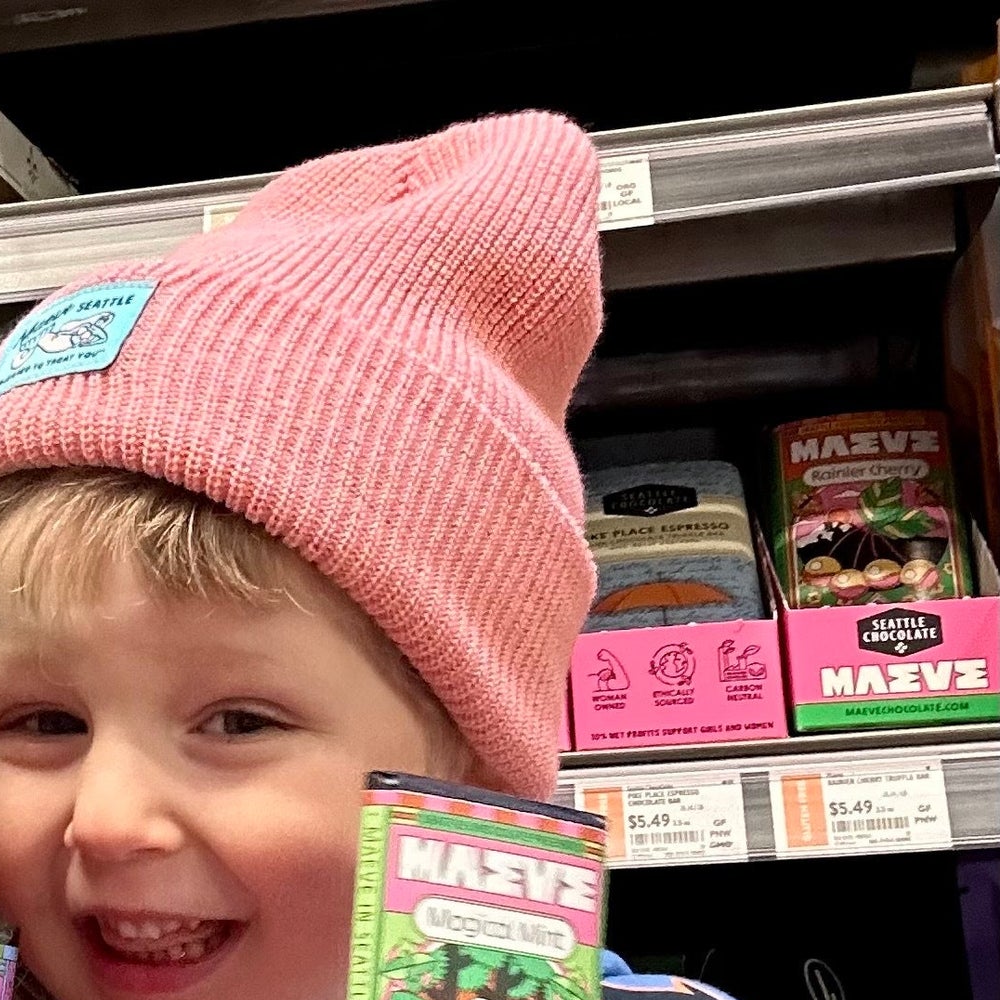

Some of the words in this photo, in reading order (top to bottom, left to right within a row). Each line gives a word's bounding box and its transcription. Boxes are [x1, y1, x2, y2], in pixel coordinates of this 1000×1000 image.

[76, 295, 135, 313] SEATTLE
[790, 430, 940, 464] MAEVE
[811, 466, 866, 482] Rainier
[868, 462, 922, 478] Cherry
[590, 532, 607, 541] KE
[613, 526, 655, 538] PLACE
[660, 522, 730, 533] ESPRESSO
[871, 616, 926, 631] SEATTLE
[862, 627, 938, 643] CHOCOLATE
[820, 658, 989, 698] MAEVE
[652, 688, 695, 698] ETHICALLY
[725, 684, 763, 693] CARBON
[592, 693, 627, 702] WOMAN
[654, 697, 694, 707] SOURCED
[727, 693, 763, 702] NEUTRAL
[594, 702, 626, 711] OWNED
[845, 702, 969, 717] MAEVECHOCOLATE.COM
[627, 728, 660, 739] PROFITS
[662, 726, 698, 737] SUPPORT
[700, 724, 723, 734] GIRLS
[725, 723, 742, 732] AND
[744, 721, 775, 731] WOMEN
[829, 800, 873, 816] $5.49
[628, 813, 670, 829] $5.49
[398, 836, 598, 913] MAEVE
